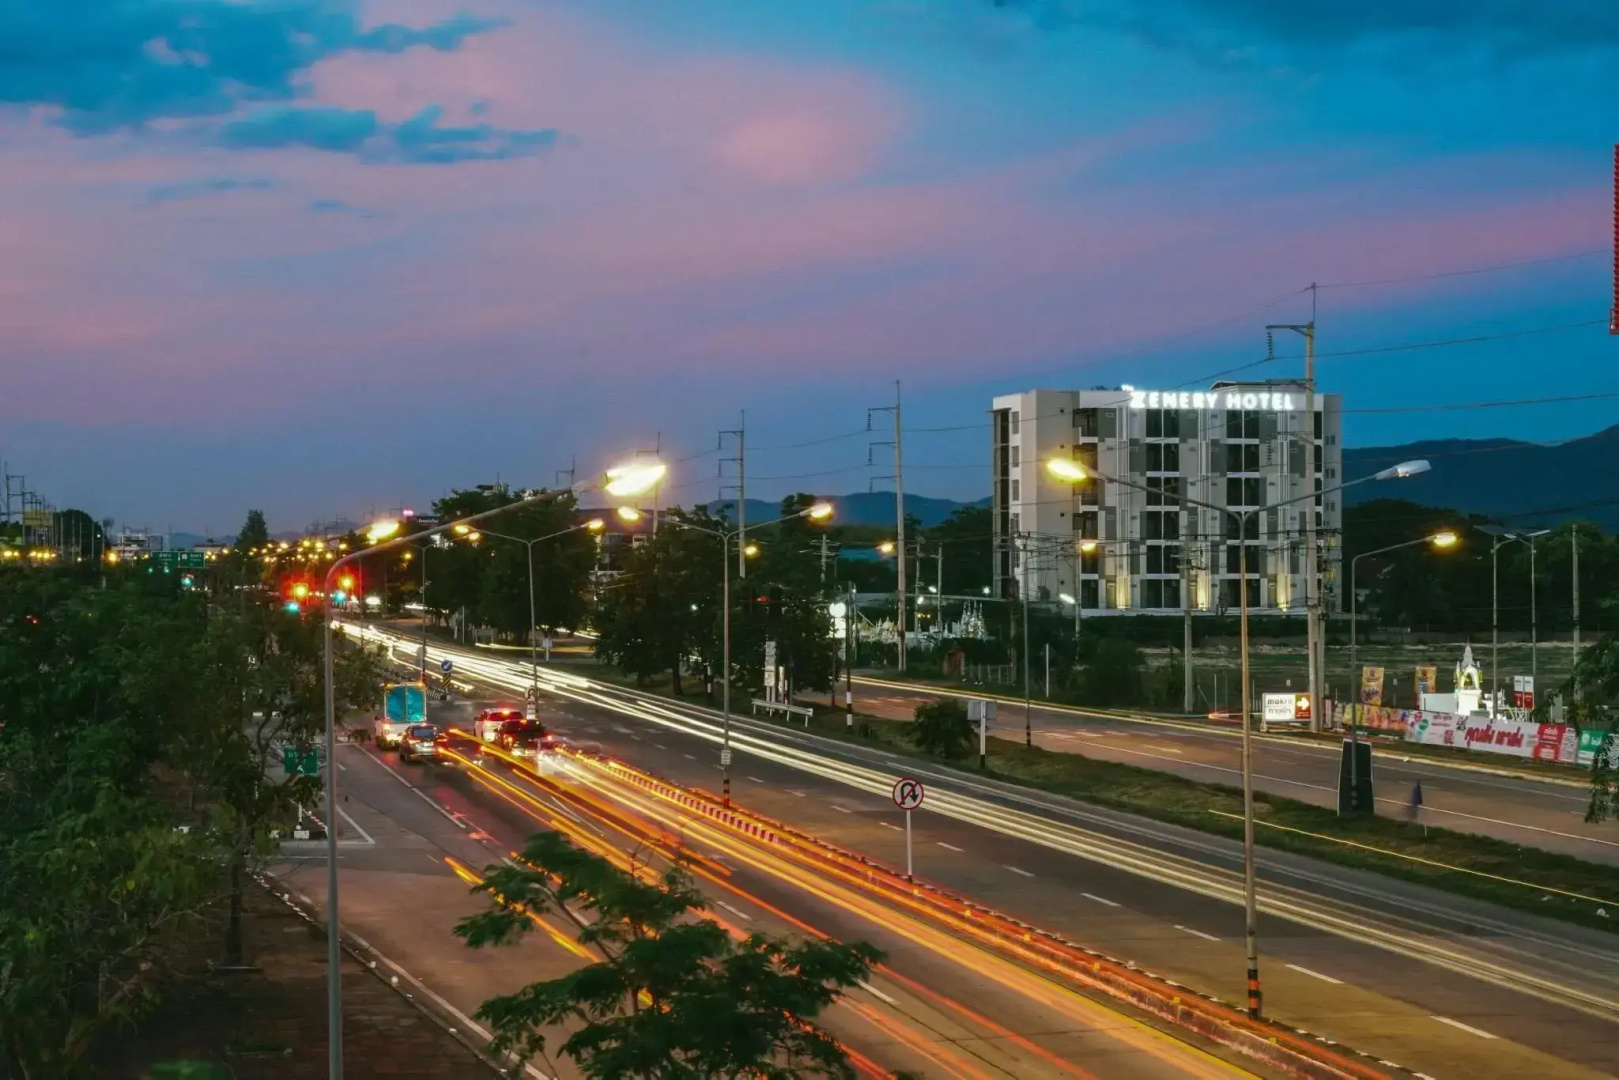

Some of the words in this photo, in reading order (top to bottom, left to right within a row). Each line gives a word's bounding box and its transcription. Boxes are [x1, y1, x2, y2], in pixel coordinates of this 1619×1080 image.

[1130, 391, 1218, 409] ZENERY
[1226, 392, 1294, 411] HOTEL
[1267, 697, 1293, 705] makro
